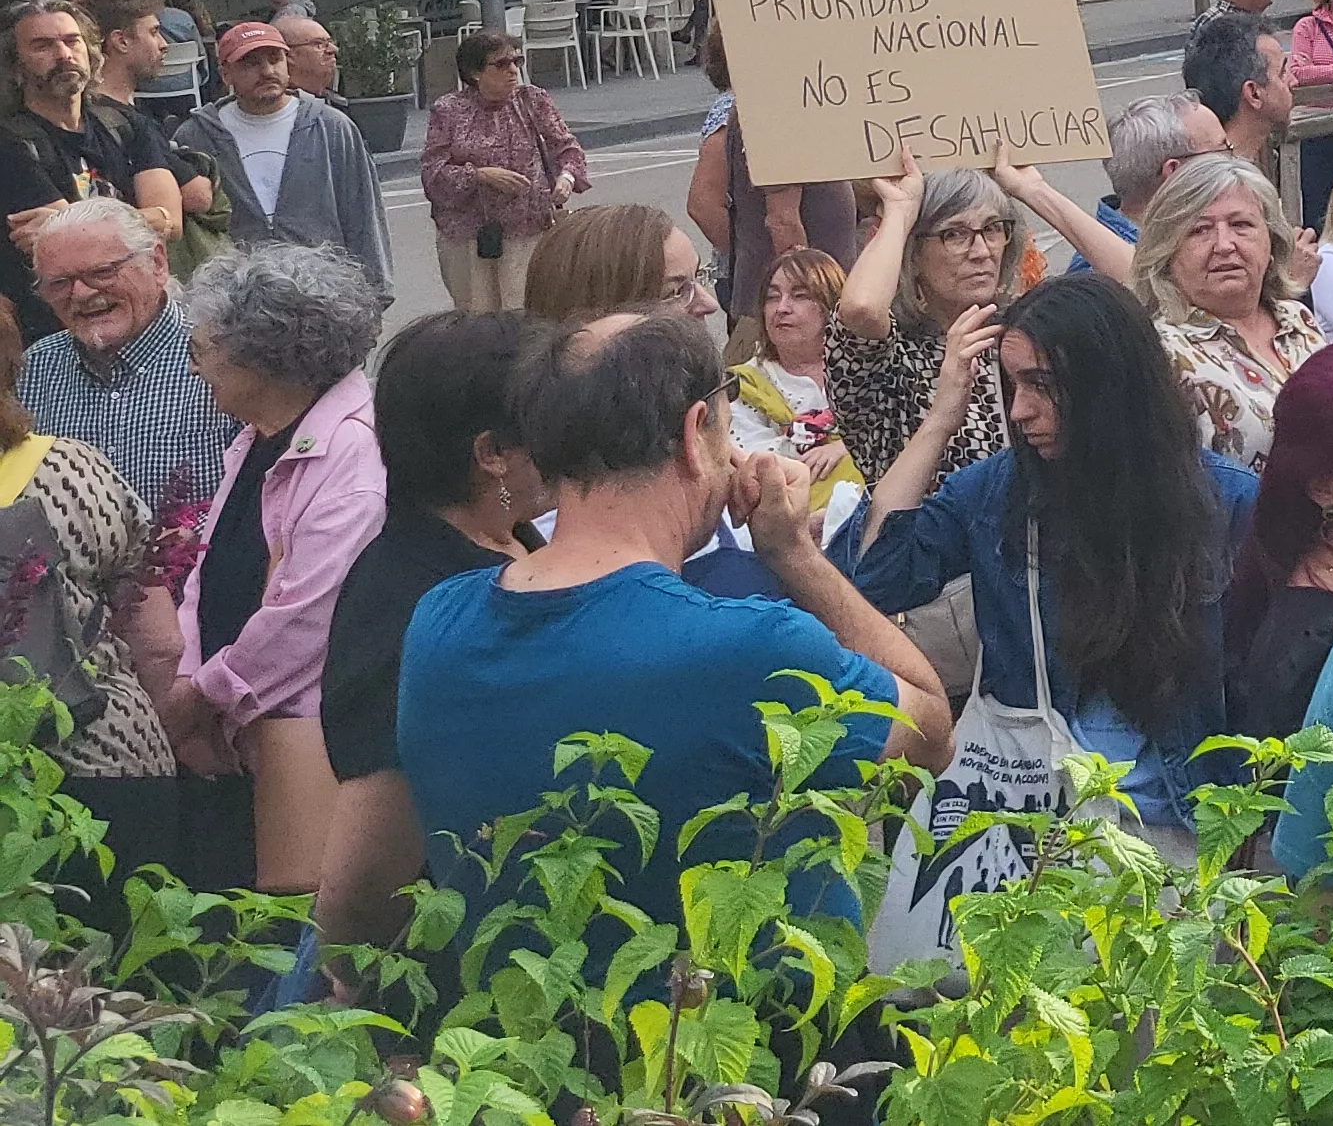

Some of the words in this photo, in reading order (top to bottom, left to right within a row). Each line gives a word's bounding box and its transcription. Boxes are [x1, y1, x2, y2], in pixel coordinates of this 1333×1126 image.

[873, 15, 1040, 55] NACIONAL
[802, 60, 847, 108] NO
[865, 70, 912, 105] ES
[863, 106, 1105, 163] DESAHUCIAR
